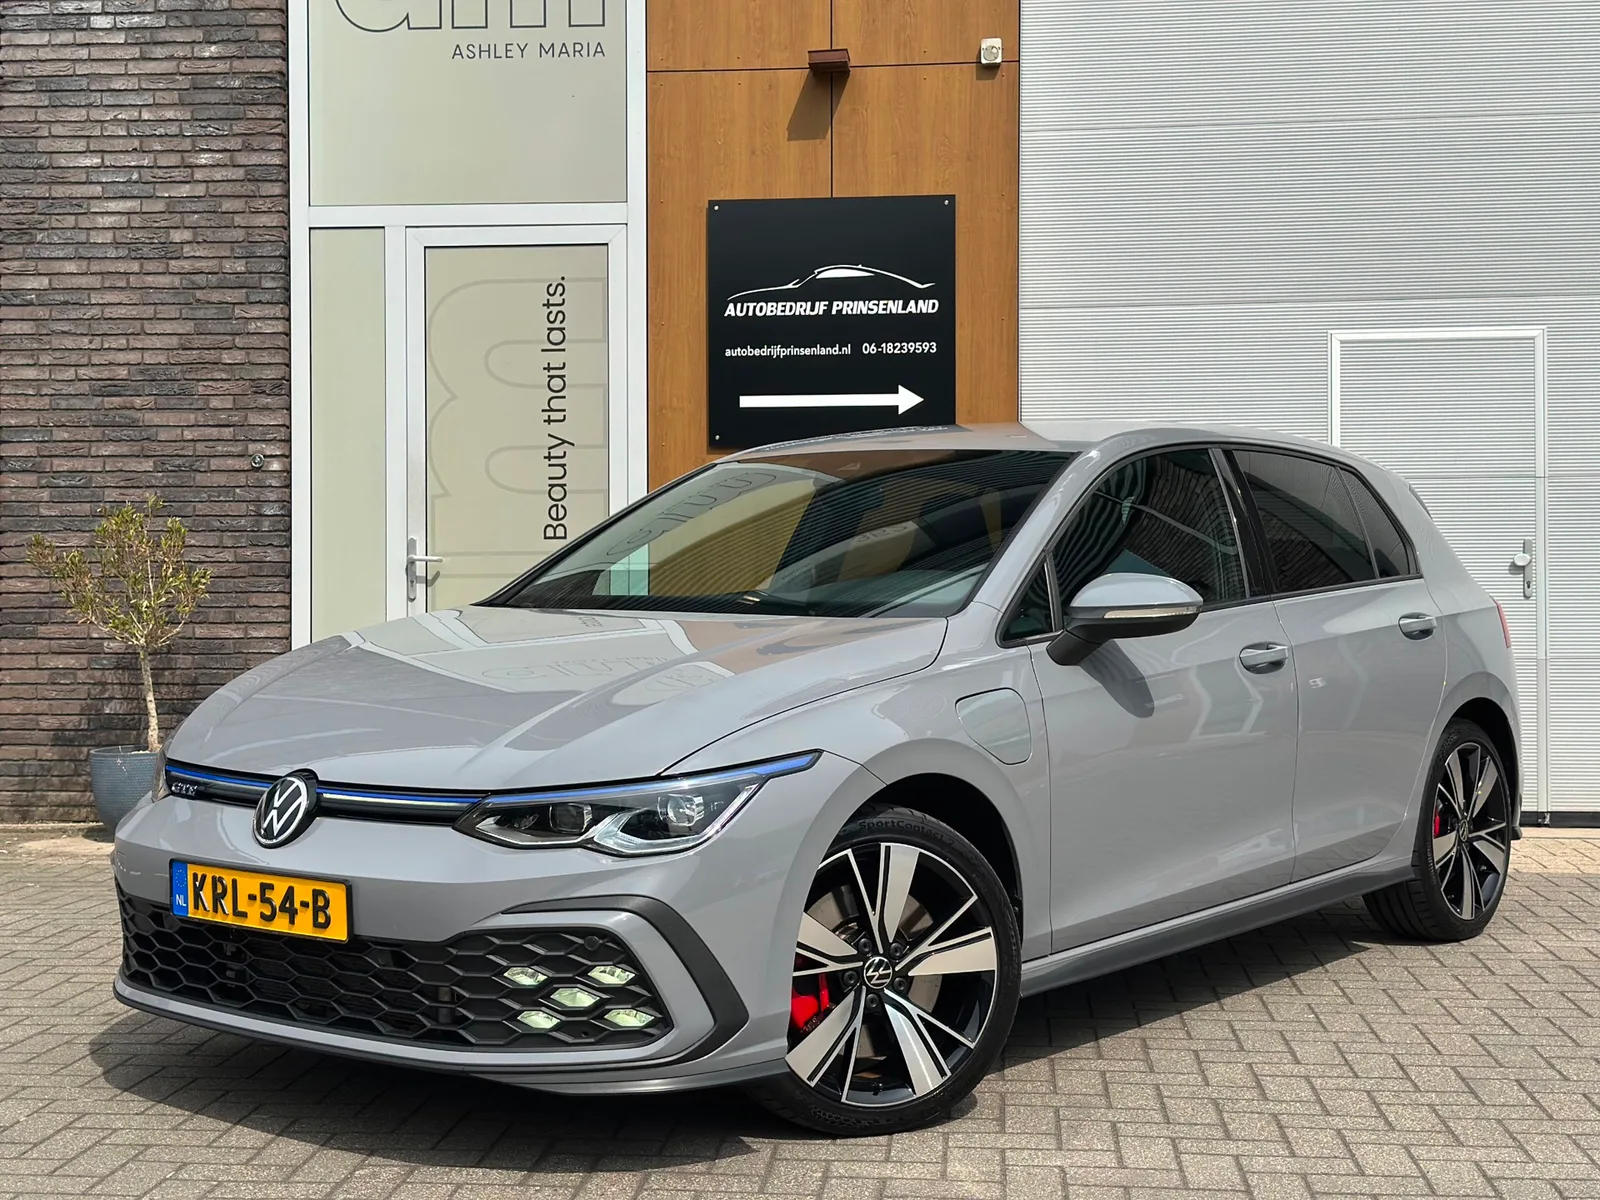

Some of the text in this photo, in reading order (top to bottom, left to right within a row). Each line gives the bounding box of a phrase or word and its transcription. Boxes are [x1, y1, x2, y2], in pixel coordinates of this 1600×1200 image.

[452, 41, 606, 60] ASHLEY MARIA
[724, 299, 939, 317] AUTOBEDRIJF PRINSENLAND
[724, 341, 937, 359] autobedrijfprinsenland.nl 06-18239593
[540, 275, 575, 540] Beauty that lasts.
[175, 871, 332, 929] NL KRL-54-B
